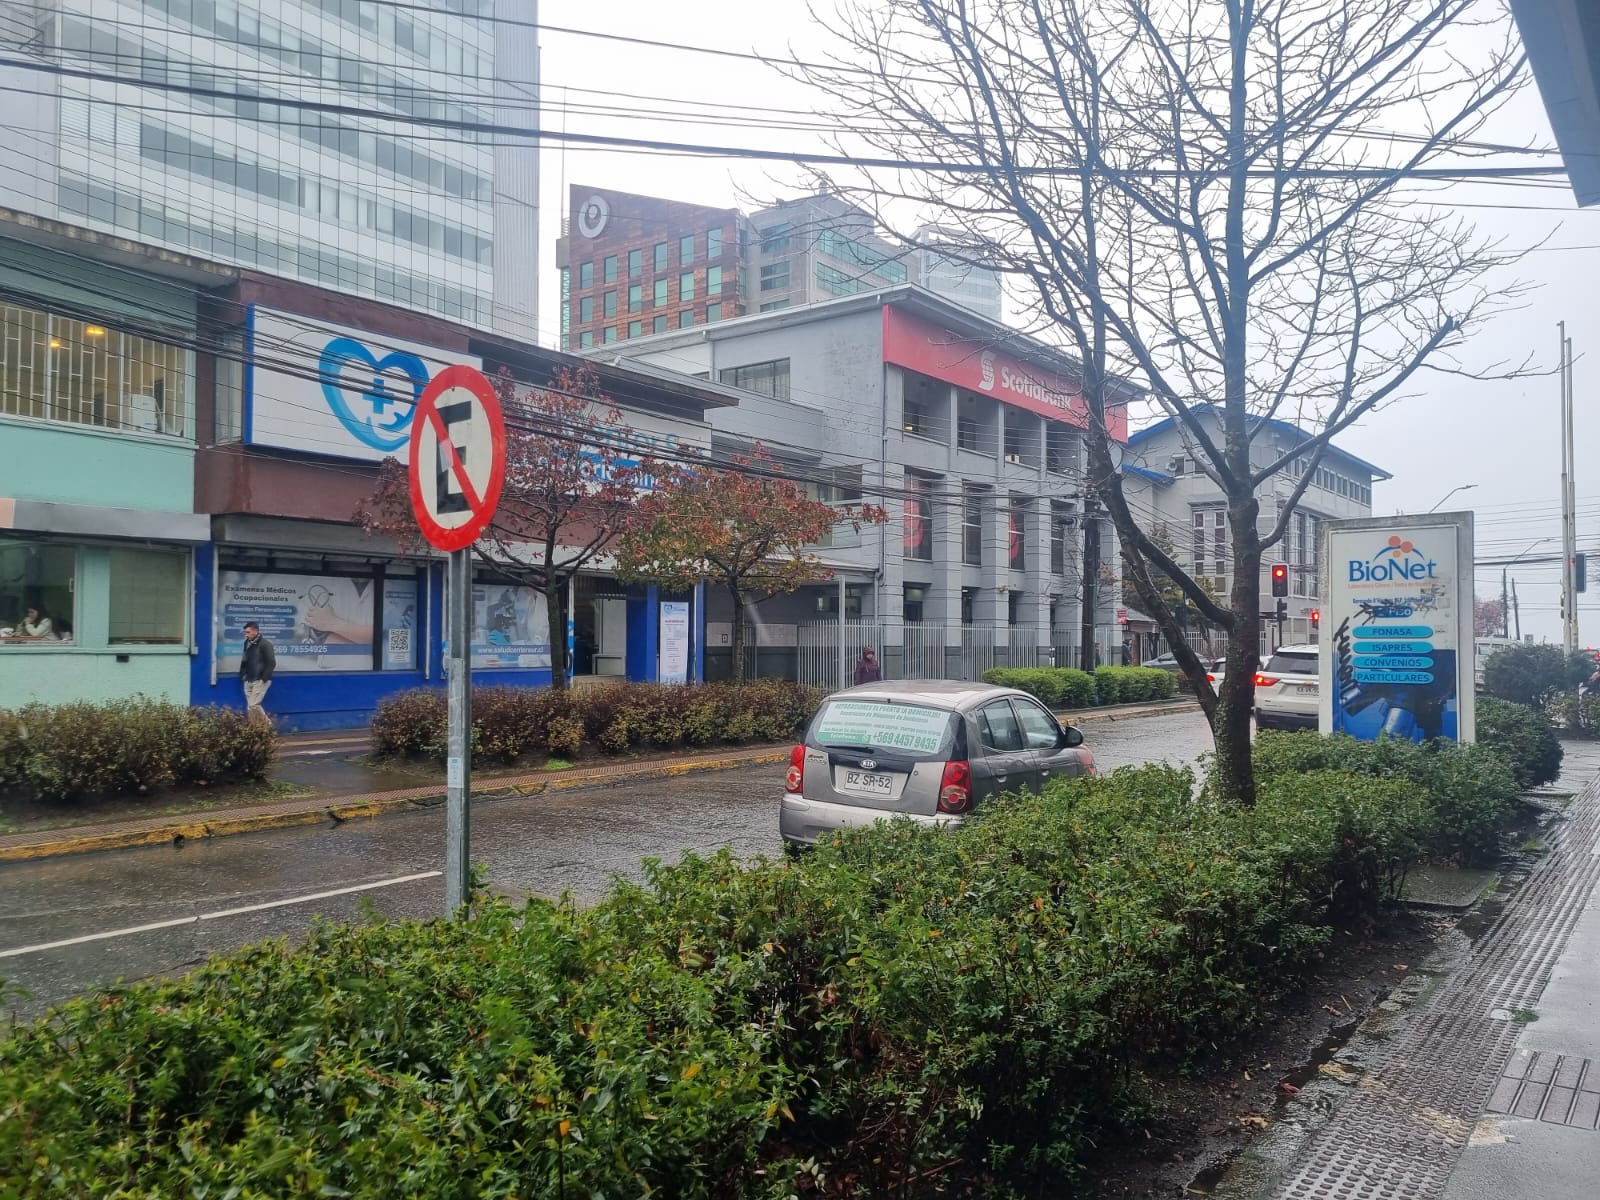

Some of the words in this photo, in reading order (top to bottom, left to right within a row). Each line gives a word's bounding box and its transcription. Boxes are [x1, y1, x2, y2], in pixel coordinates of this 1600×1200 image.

[436, 401, 472, 514] E
[1349, 558, 1437, 582] BioNet
[1372, 628, 1413, 636] FONASA
[1373, 644, 1413, 652] ISAPRES
[1364, 659, 1422, 667] CONVENIOS
[1357, 673, 1430, 682] PARTICULARES
[861, 760, 876, 768] KIA
[846, 772, 860, 785] BZ
